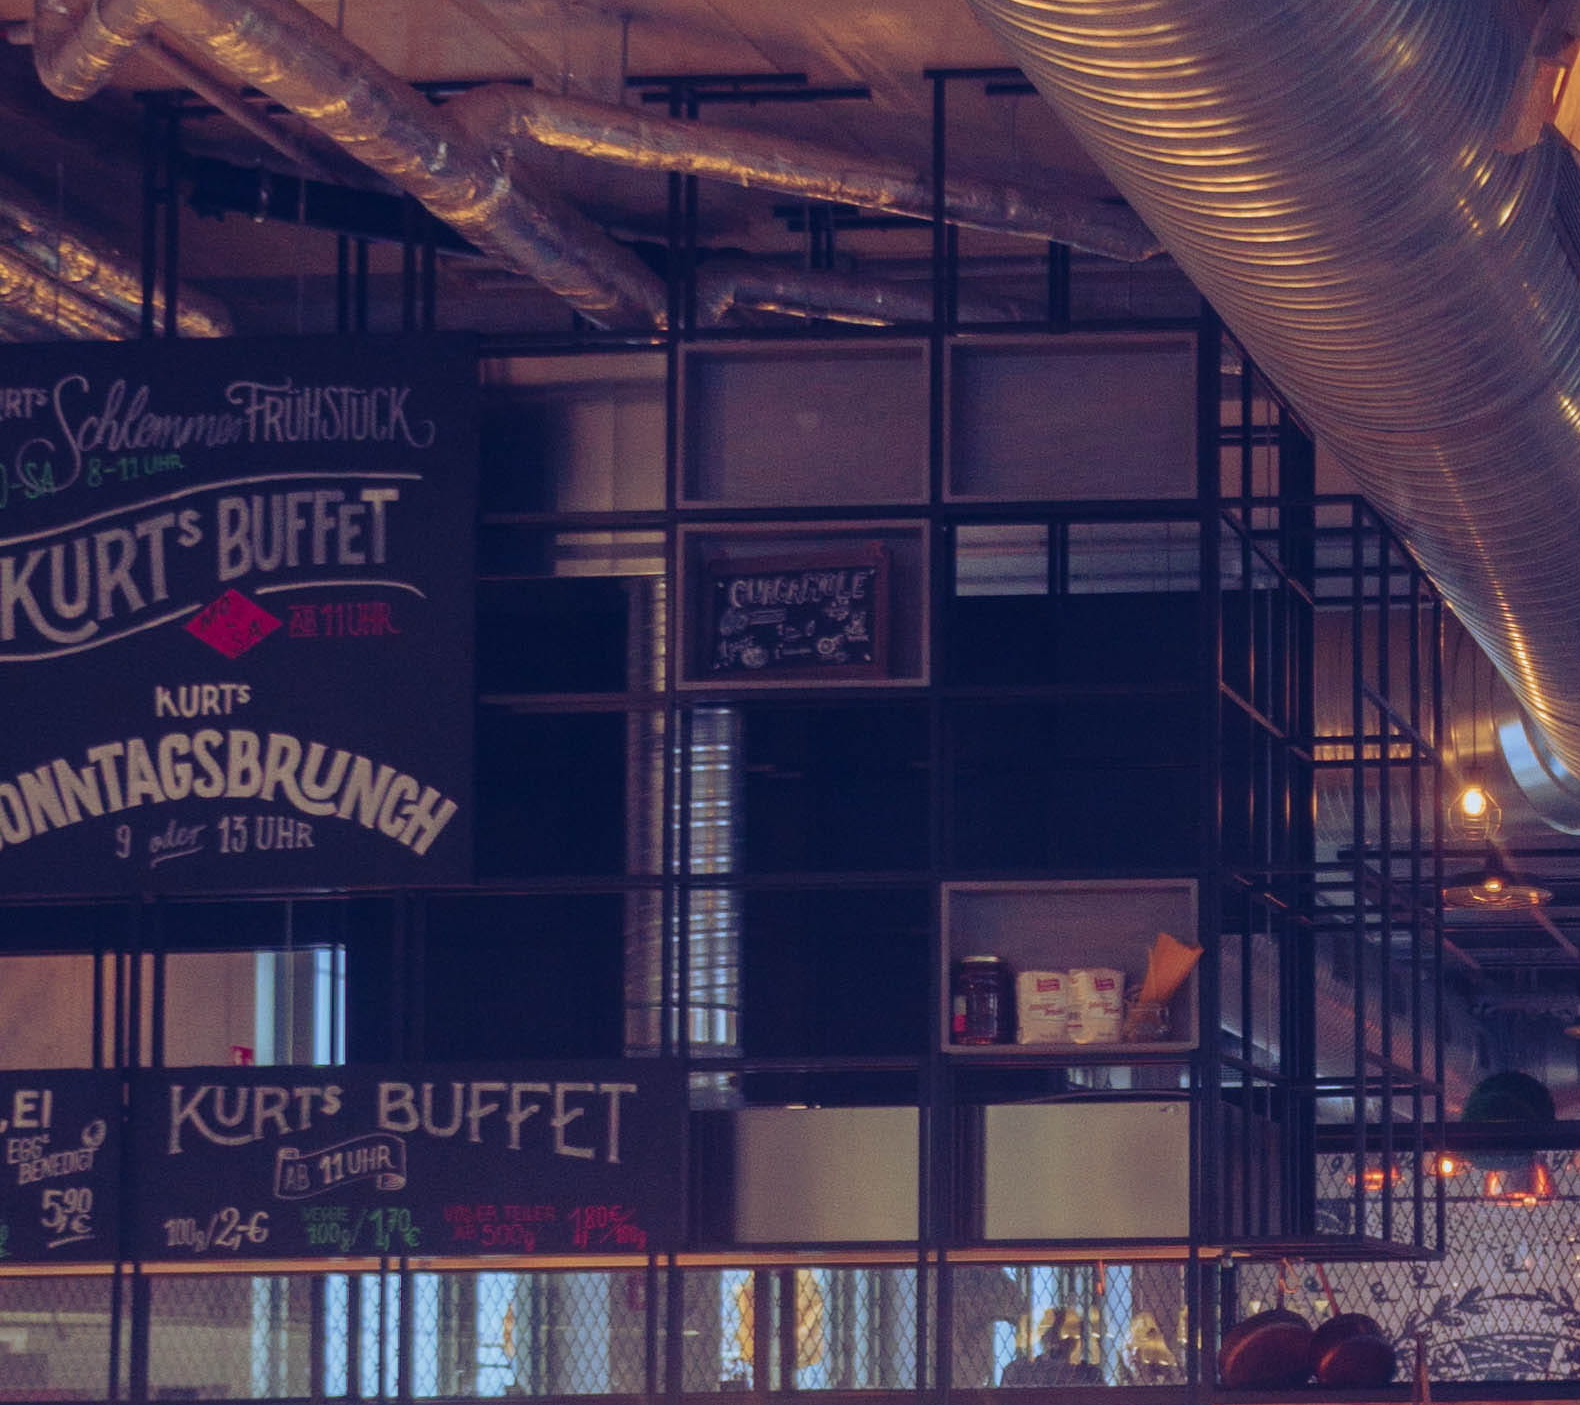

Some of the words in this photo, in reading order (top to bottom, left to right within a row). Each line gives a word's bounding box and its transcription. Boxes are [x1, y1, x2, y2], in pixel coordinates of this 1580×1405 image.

[226, 378, 435, 449] FRÜHSTÜCK
[216, 488, 400, 582] BUFFET
[0, 728, 458, 856] ONNTAGSBRUNCH
[114, 823, 132, 859] 9
[148, 820, 209, 855] oder
[217, 816, 247, 854] 13
[253, 820, 315, 851] UHR
[377, 1082, 638, 1163] BUFFET
[284, 1163, 311, 1191] AB
[319, 1152, 345, 1185] 11
[346, 1145, 397, 1174] UHR
